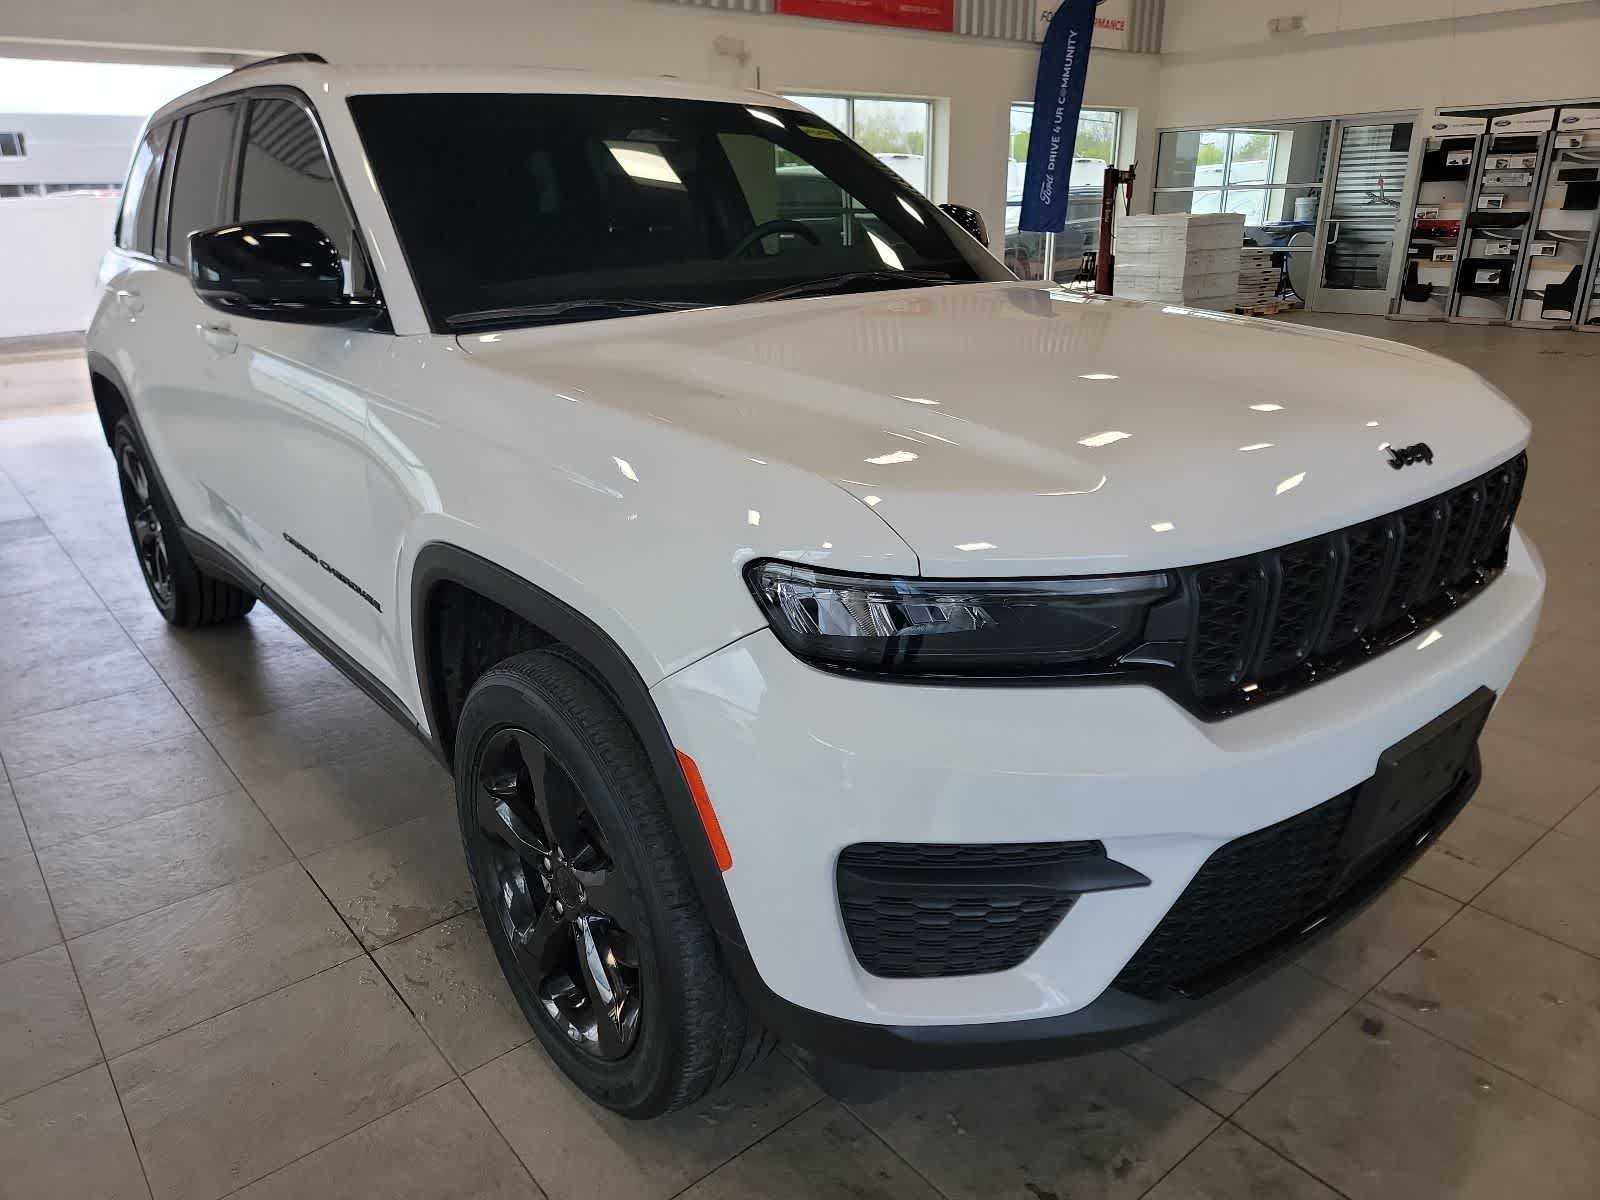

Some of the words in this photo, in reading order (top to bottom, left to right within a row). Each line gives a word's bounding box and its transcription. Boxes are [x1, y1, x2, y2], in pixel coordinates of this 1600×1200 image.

[1040, 10, 1055, 22] FO
[1040, 174, 1054, 205] Ford
[1048, 135, 1061, 171] DRIVE
[1055, 107, 1064, 124] UR
[1385, 442, 1434, 470] Jeep
